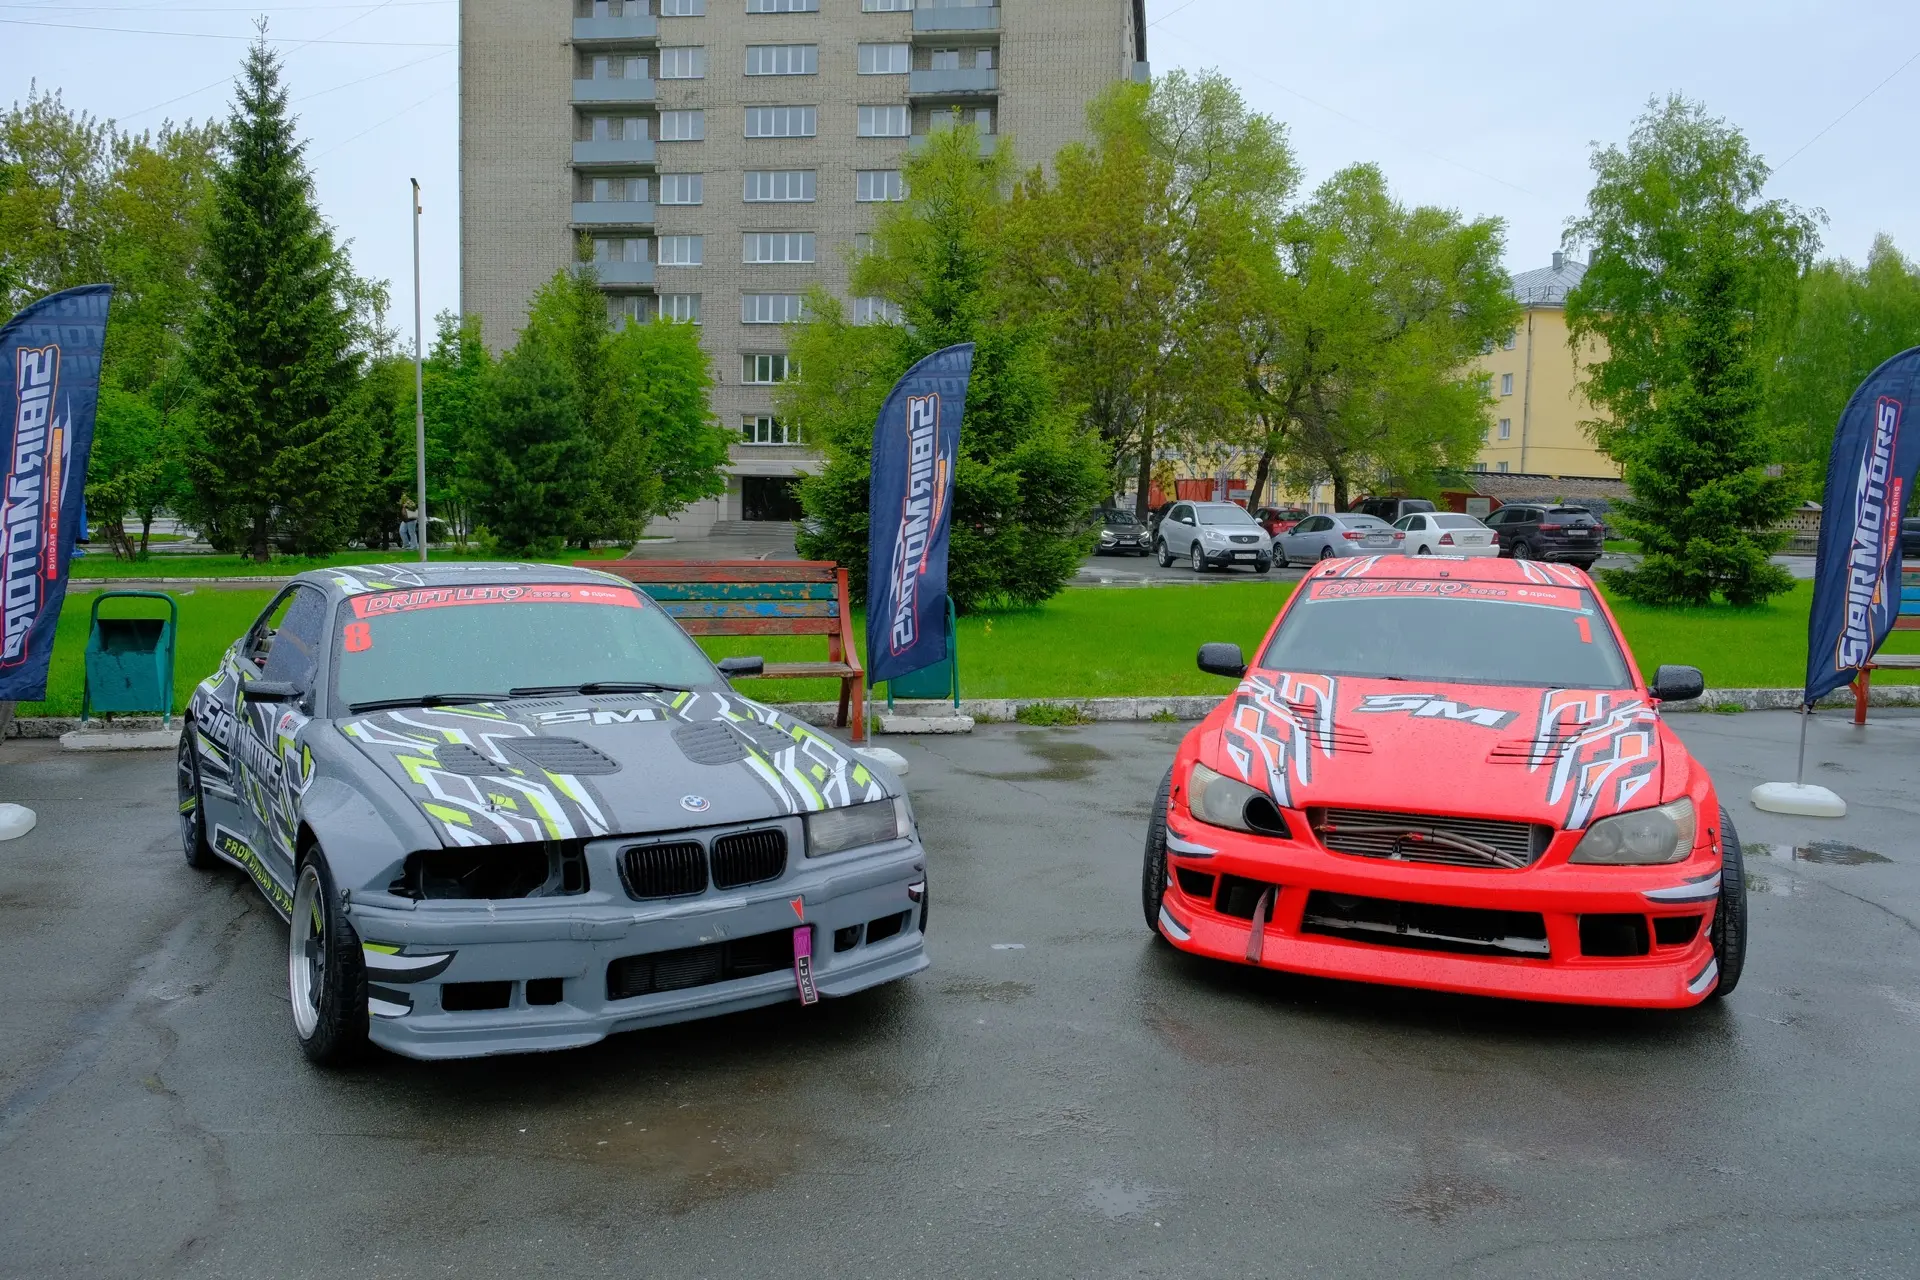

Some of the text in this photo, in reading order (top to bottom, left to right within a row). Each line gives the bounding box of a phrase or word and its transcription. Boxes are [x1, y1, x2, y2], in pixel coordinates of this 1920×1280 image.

[1891, 486, 1900, 517] RACING
[367, 589, 453, 611] DRIFT
[457, 587, 524, 600] LETO
[1319, 582, 1397, 596] DRIFT
[1397, 581, 1462, 593] LETO
[343, 622, 372, 653] 8
[1574, 616, 1593, 644] 1
[531, 708, 657, 726] SM
[1358, 694, 1508, 727] SM
[225, 838, 251, 862] FROM
[272, 883, 283, 901] TO
[799, 959, 813, 994] LUKE
